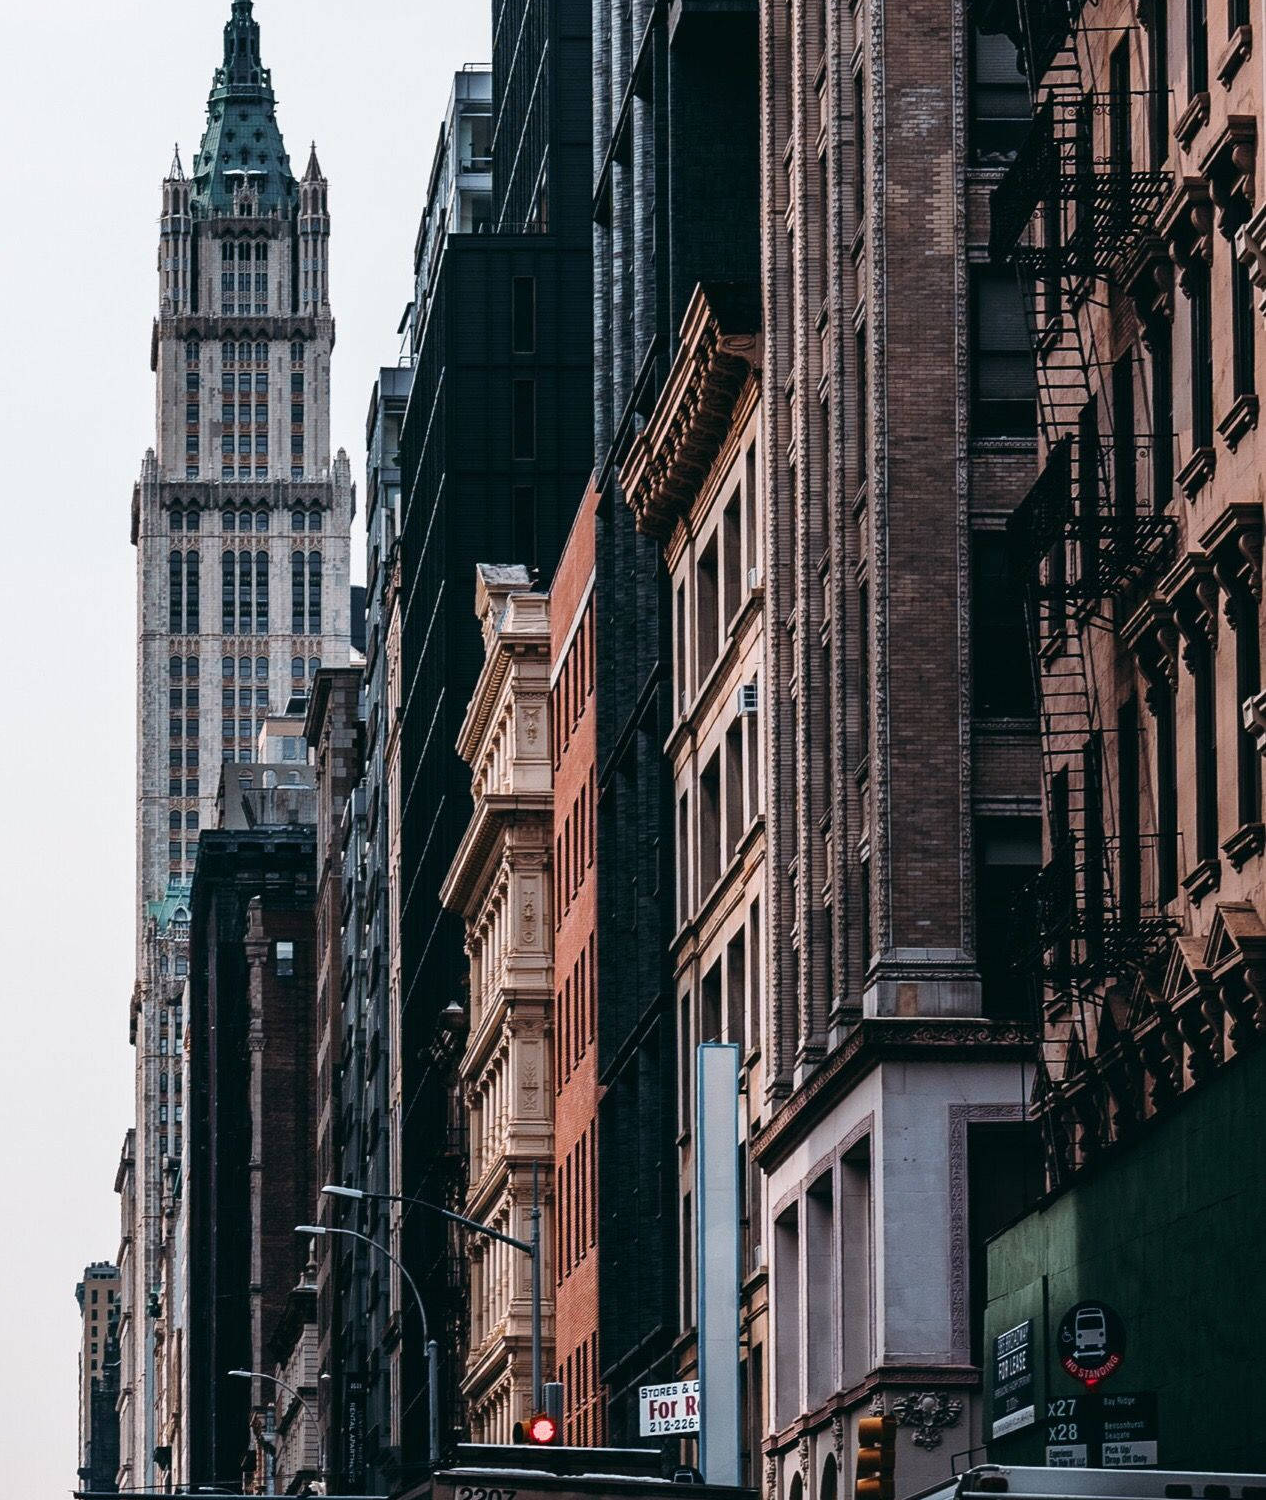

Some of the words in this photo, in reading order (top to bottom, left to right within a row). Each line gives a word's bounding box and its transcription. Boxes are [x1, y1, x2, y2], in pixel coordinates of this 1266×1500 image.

[999, 1359, 1009, 1381] FOR
[1010, 1350, 1027, 1376] LEASE
[1065, 1357, 1079, 1374] NO
[1078, 1355, 1119, 1380] STANDING
[641, 1386, 677, 1398] STORES
[649, 1400, 677, 1420] For
[650, 1418, 698, 1432] 212-226-
[1105, 1446, 1119, 1454] Pick
[1105, 1456, 1120, 1465] Drop
[1122, 1455, 1131, 1463] Off
[1133, 1454, 1147, 1463] Only
